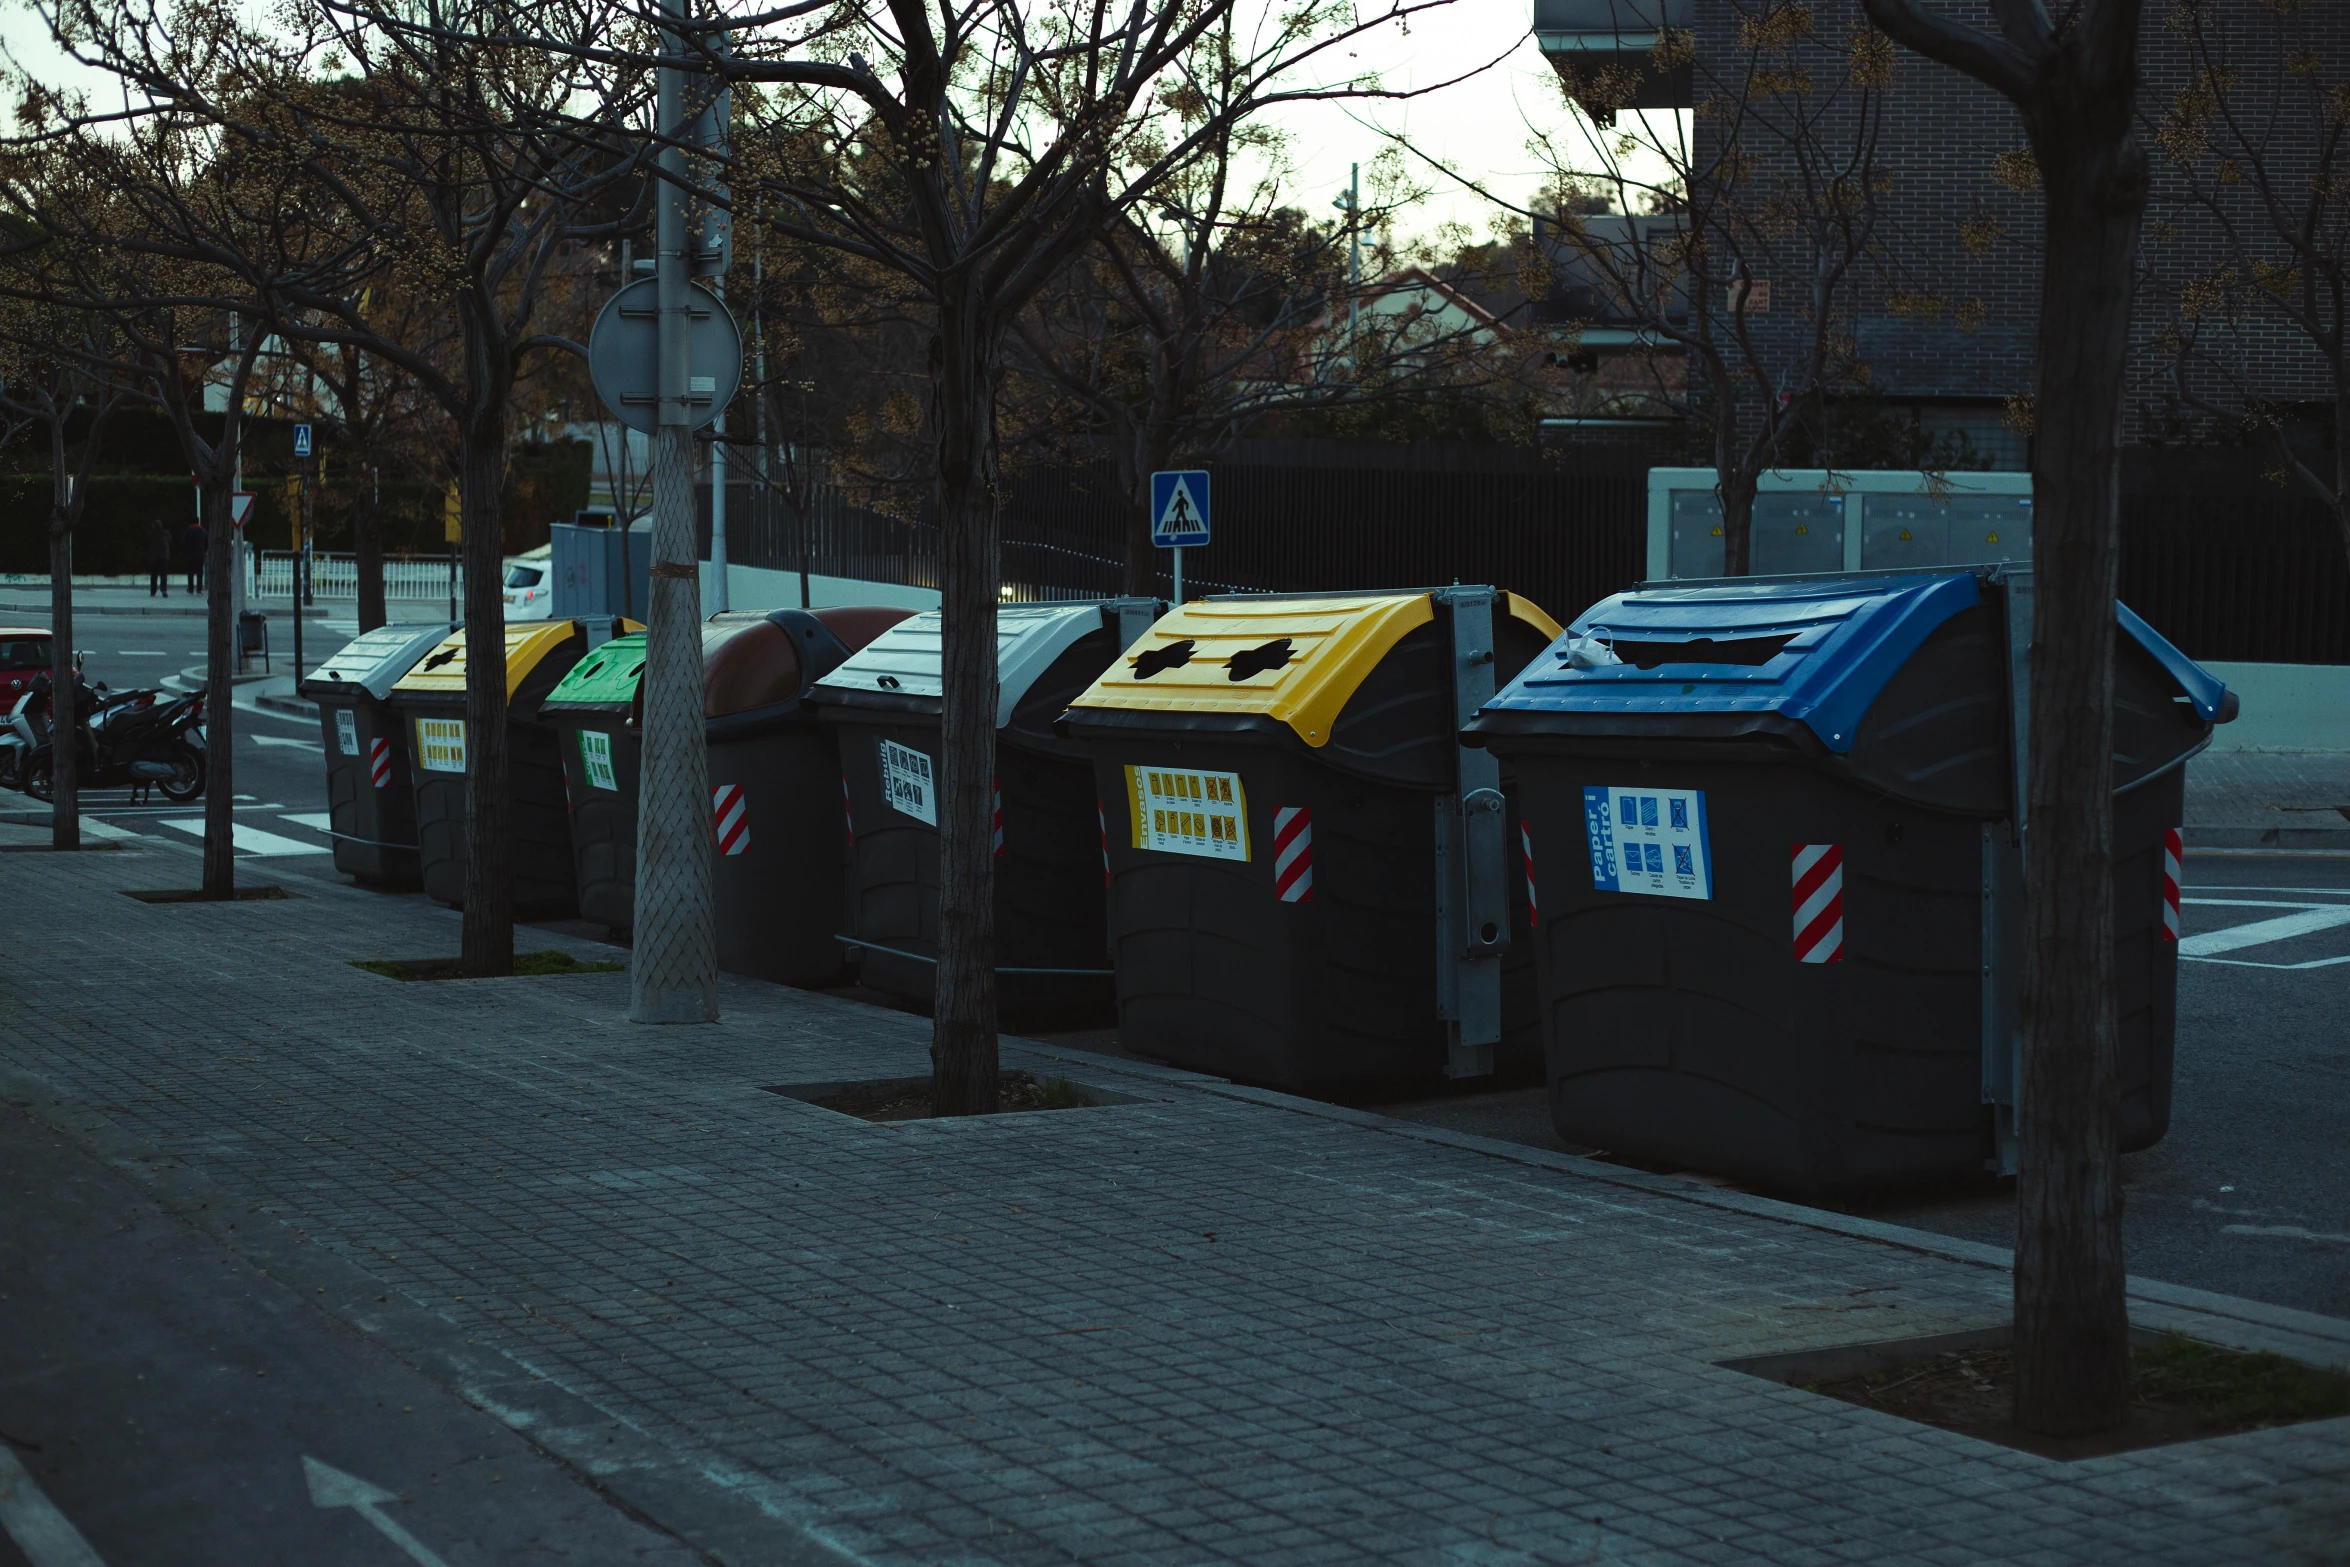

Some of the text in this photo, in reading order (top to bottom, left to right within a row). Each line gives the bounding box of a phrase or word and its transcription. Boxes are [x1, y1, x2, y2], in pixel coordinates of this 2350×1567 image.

[880, 742, 892, 802] Rebuig
[1134, 766, 1148, 849] Envasos
[1588, 808, 1606, 881] Paper
[1597, 802, 1617, 877] cartró
